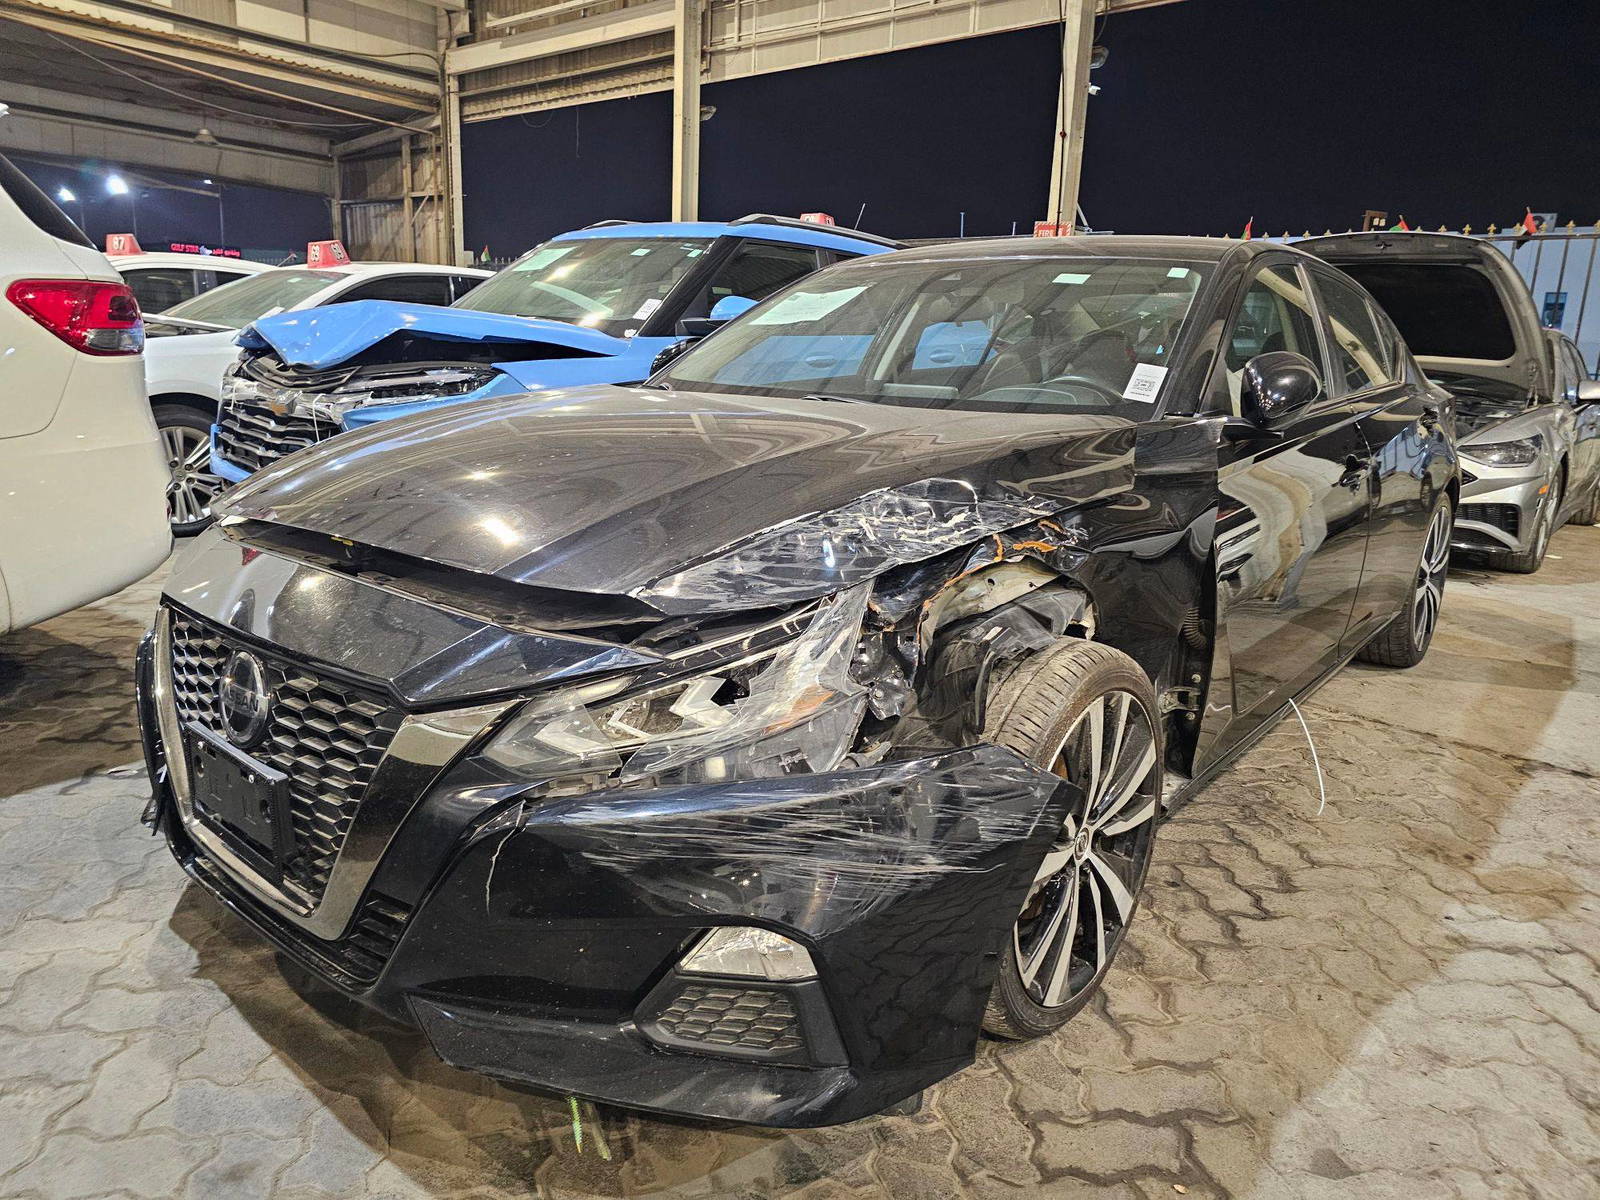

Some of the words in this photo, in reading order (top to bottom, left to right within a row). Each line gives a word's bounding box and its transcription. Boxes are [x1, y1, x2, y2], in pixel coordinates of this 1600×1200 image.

[112, 236, 125, 251] 87
[170, 243, 185, 252] GULF
[185, 244, 200, 253] STAR
